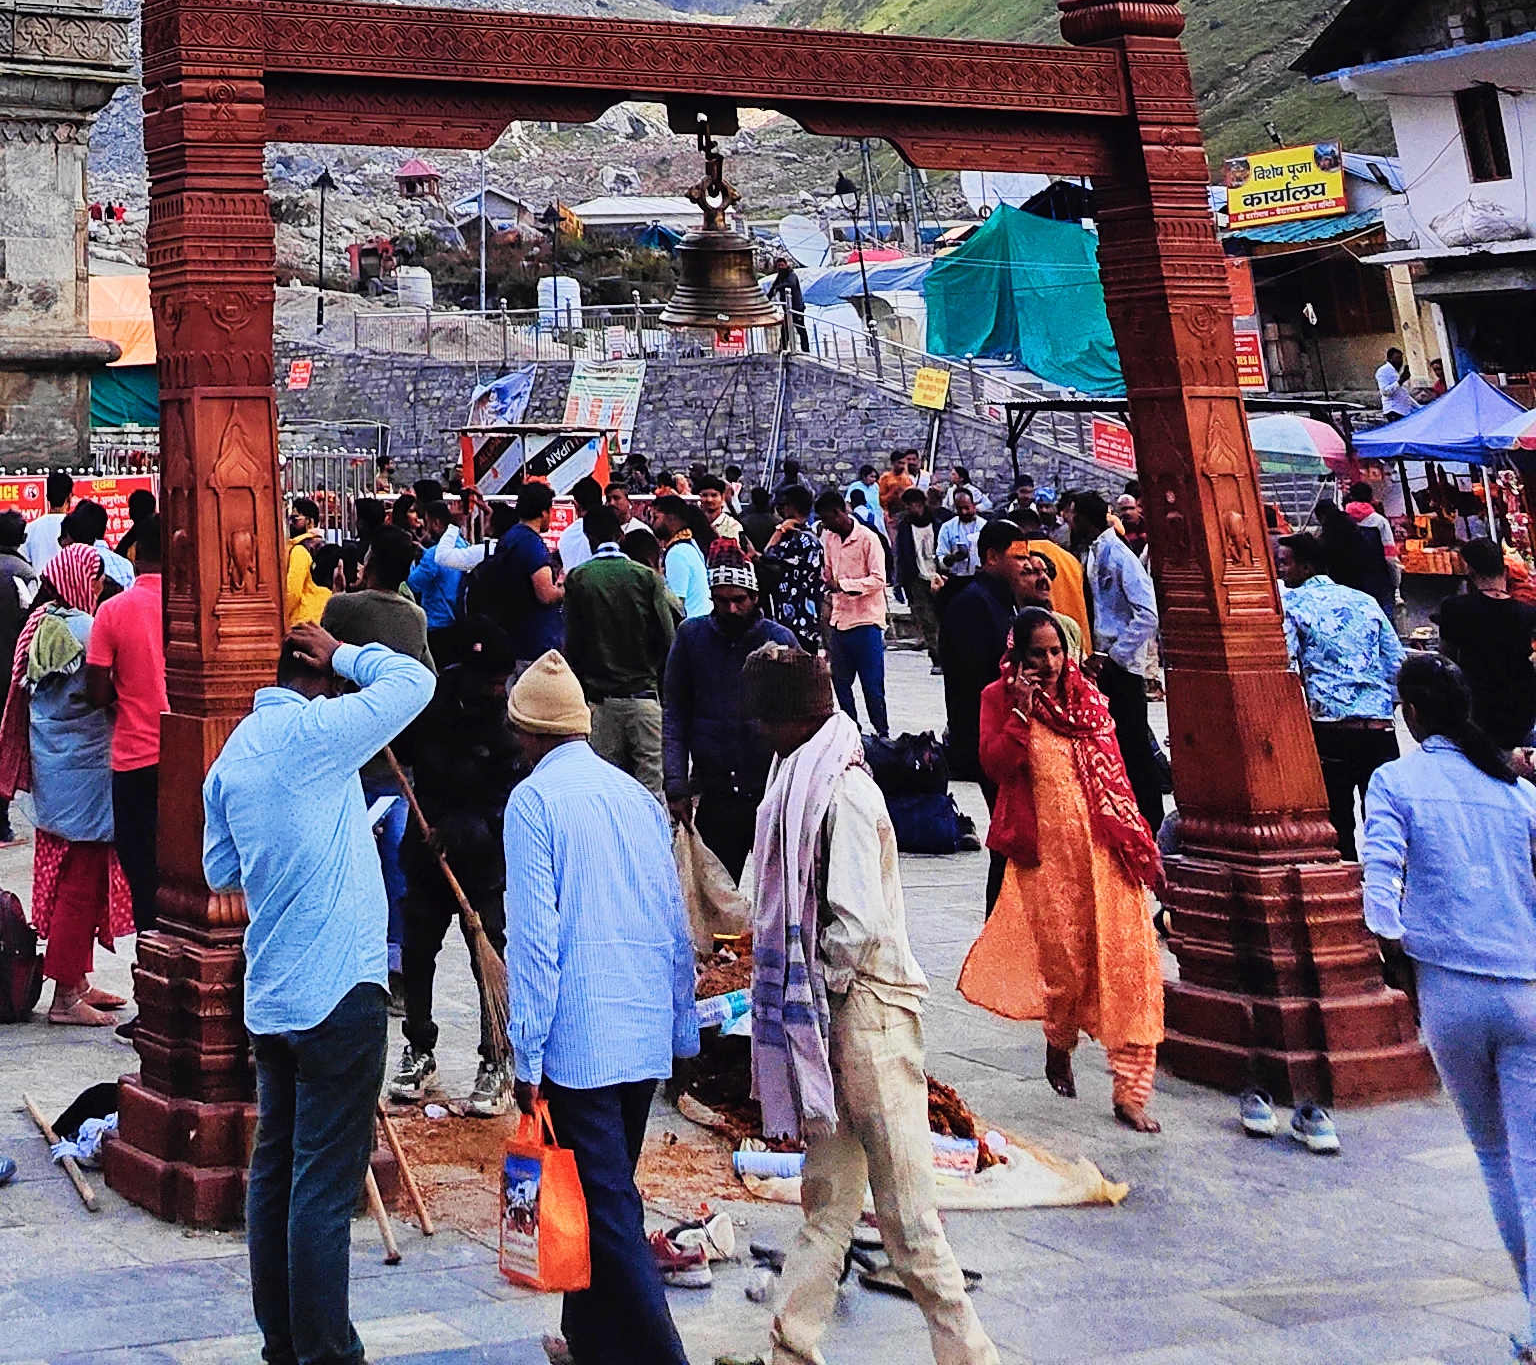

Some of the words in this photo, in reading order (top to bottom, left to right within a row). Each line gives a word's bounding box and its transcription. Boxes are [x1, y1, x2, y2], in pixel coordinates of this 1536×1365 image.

[1253, 163, 1284, 181] विशेष
[1287, 161, 1312, 181] पूजा
[1242, 181, 1327, 207] कार्यालय
